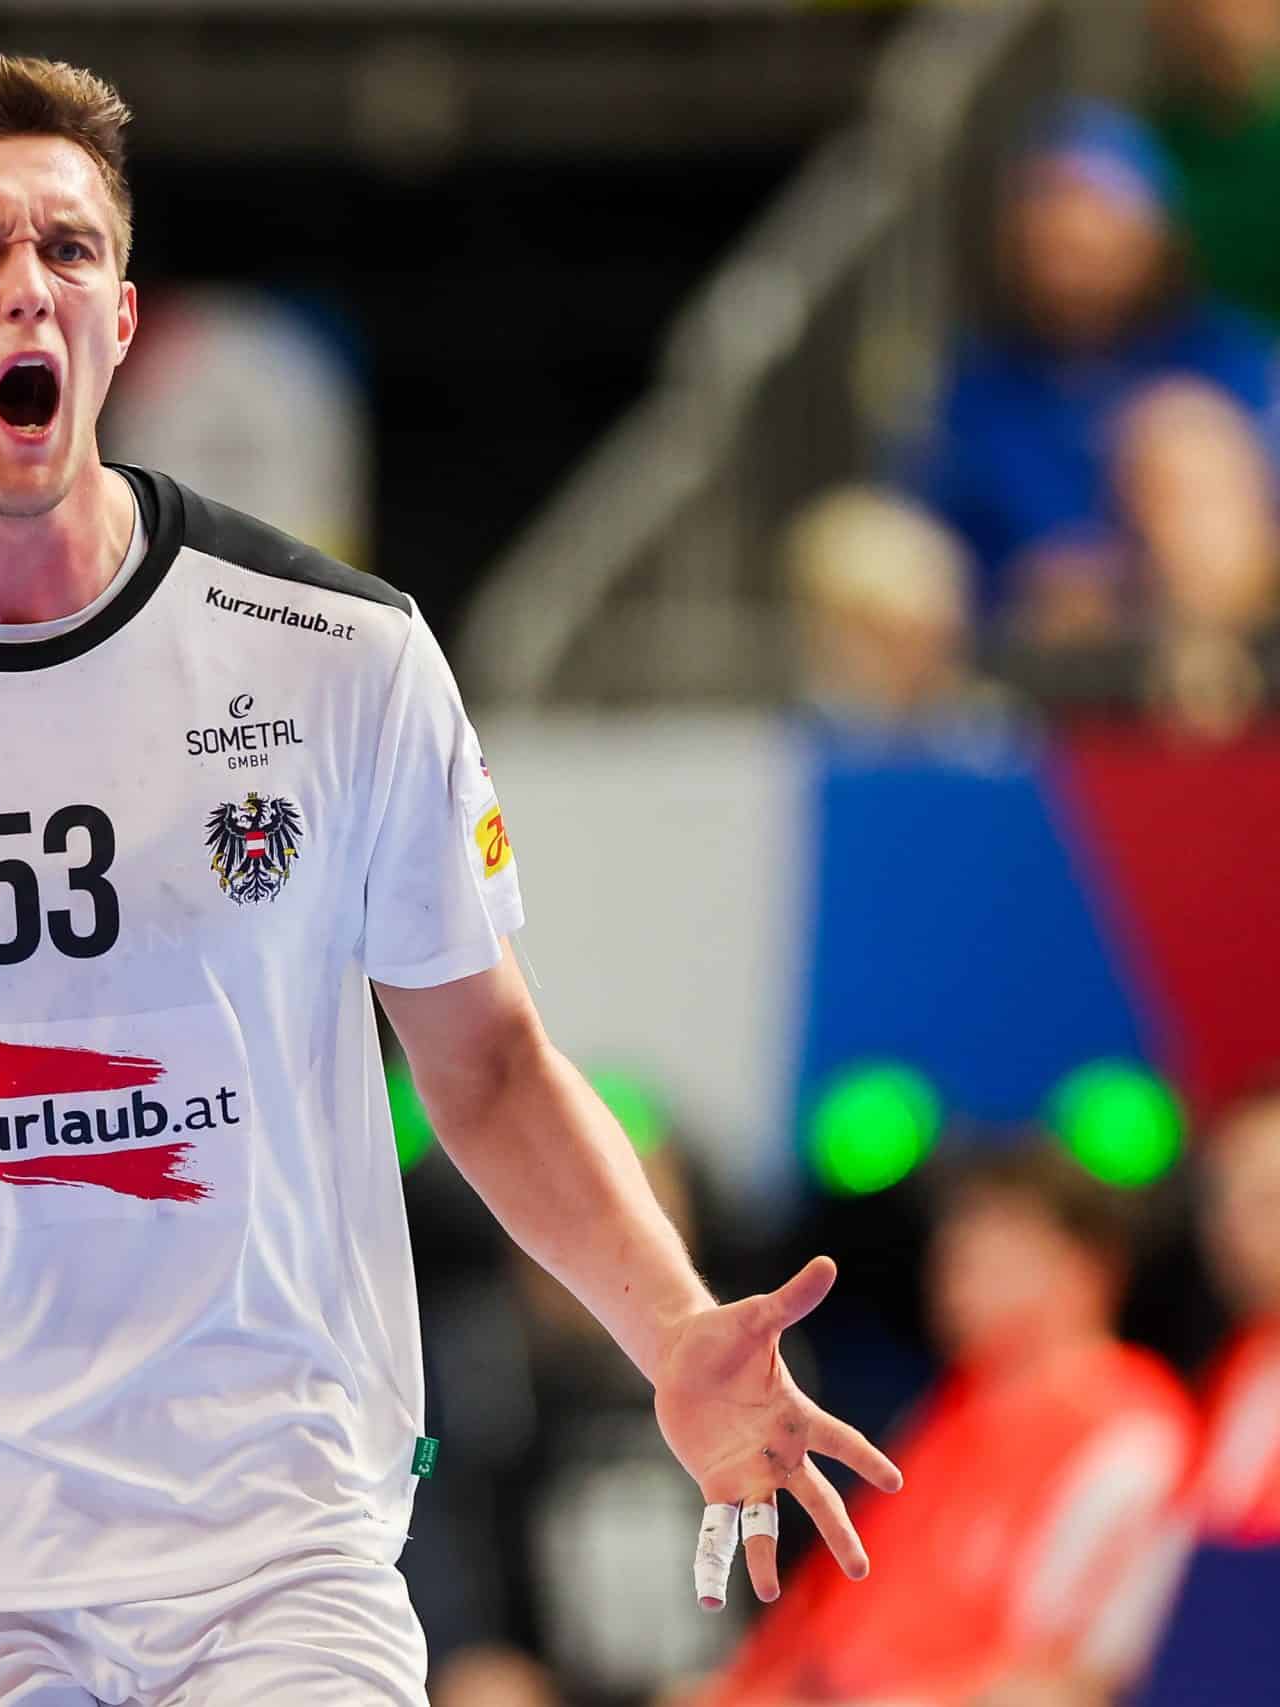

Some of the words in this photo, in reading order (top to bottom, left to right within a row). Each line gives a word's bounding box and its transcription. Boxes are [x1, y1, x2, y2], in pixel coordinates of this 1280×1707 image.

[205, 586, 356, 641] Kurzurlaub.at
[185, 718, 303, 756] SOMETAL
[227, 753, 269, 770] GMBH
